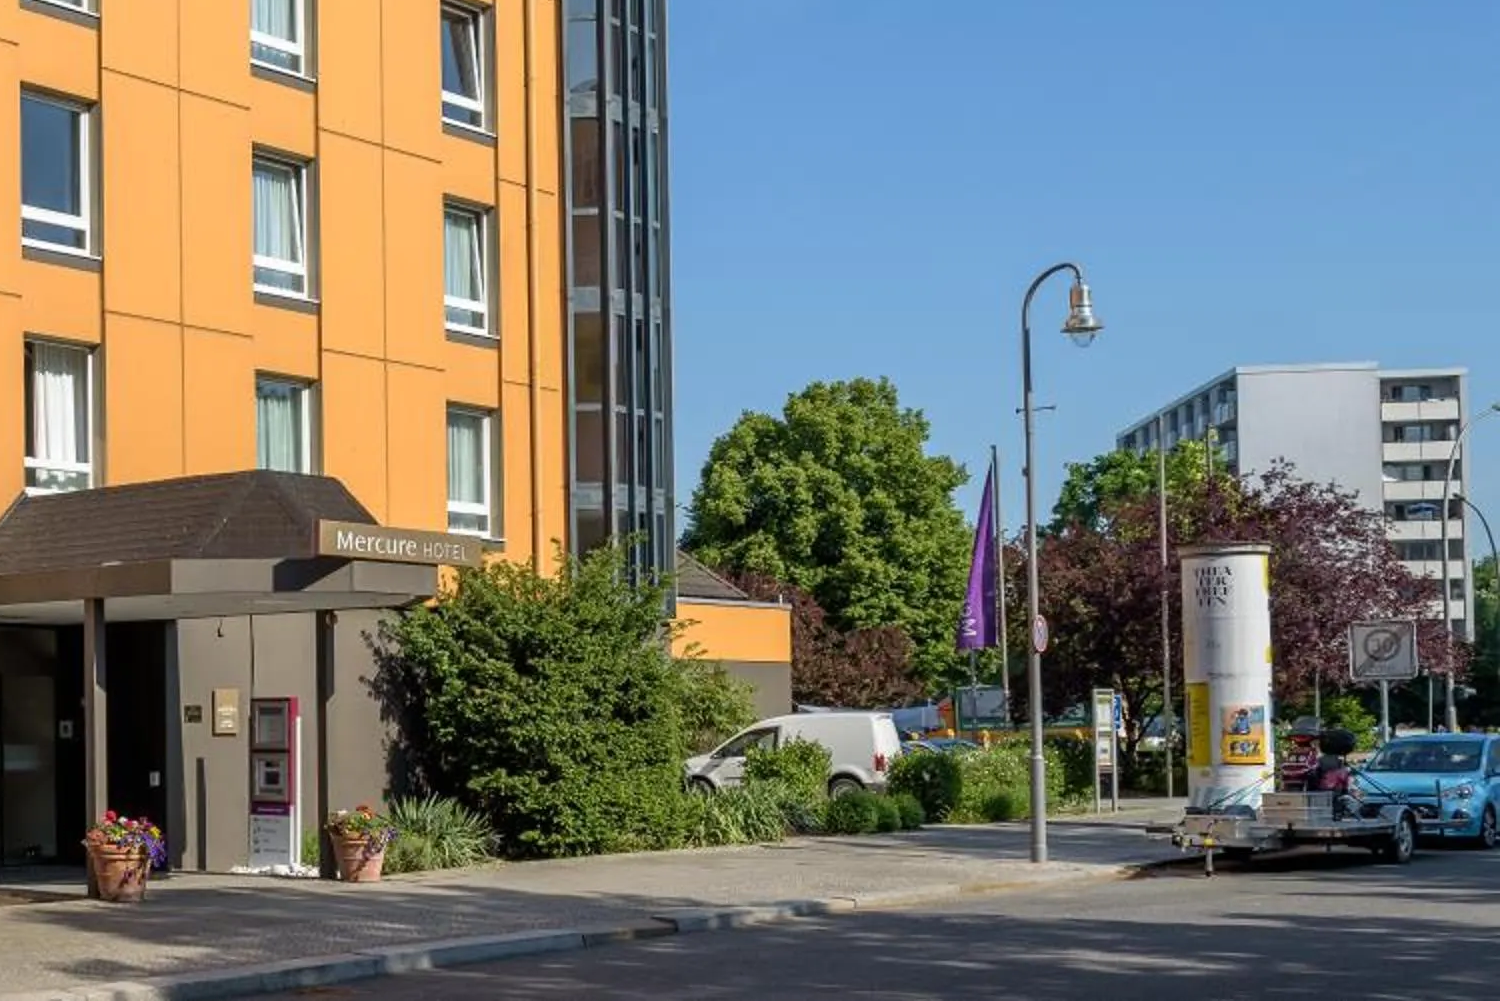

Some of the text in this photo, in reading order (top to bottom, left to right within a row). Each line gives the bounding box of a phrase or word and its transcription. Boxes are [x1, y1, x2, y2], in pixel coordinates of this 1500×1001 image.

[336, 530, 468, 561] Mercure HOTEL
[1371, 638, 1395, 655] 30
